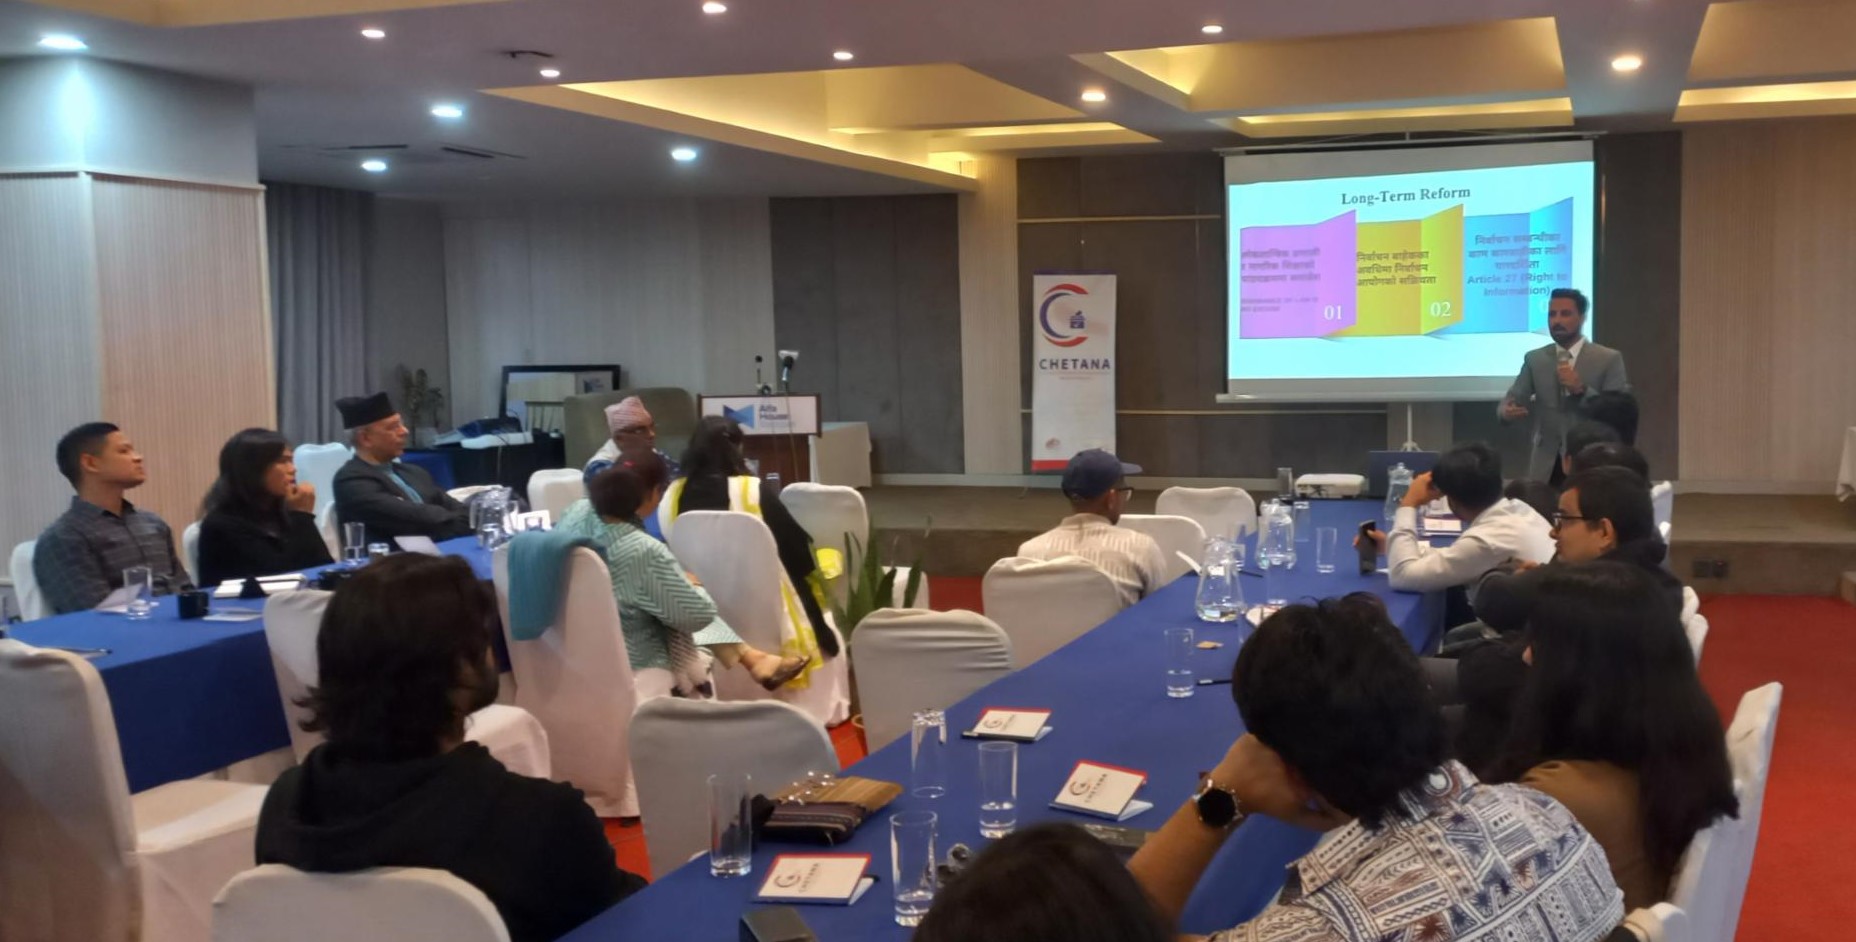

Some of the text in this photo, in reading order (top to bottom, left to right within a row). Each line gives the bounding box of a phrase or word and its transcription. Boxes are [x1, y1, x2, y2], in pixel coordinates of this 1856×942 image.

[1341, 187, 1471, 206] Long-Term Reform
[1467, 274, 1500, 284] Article
[1324, 305, 1342, 320] 01
[1430, 301, 1451, 317] 02
[1039, 358, 1111, 370] CHETANA
